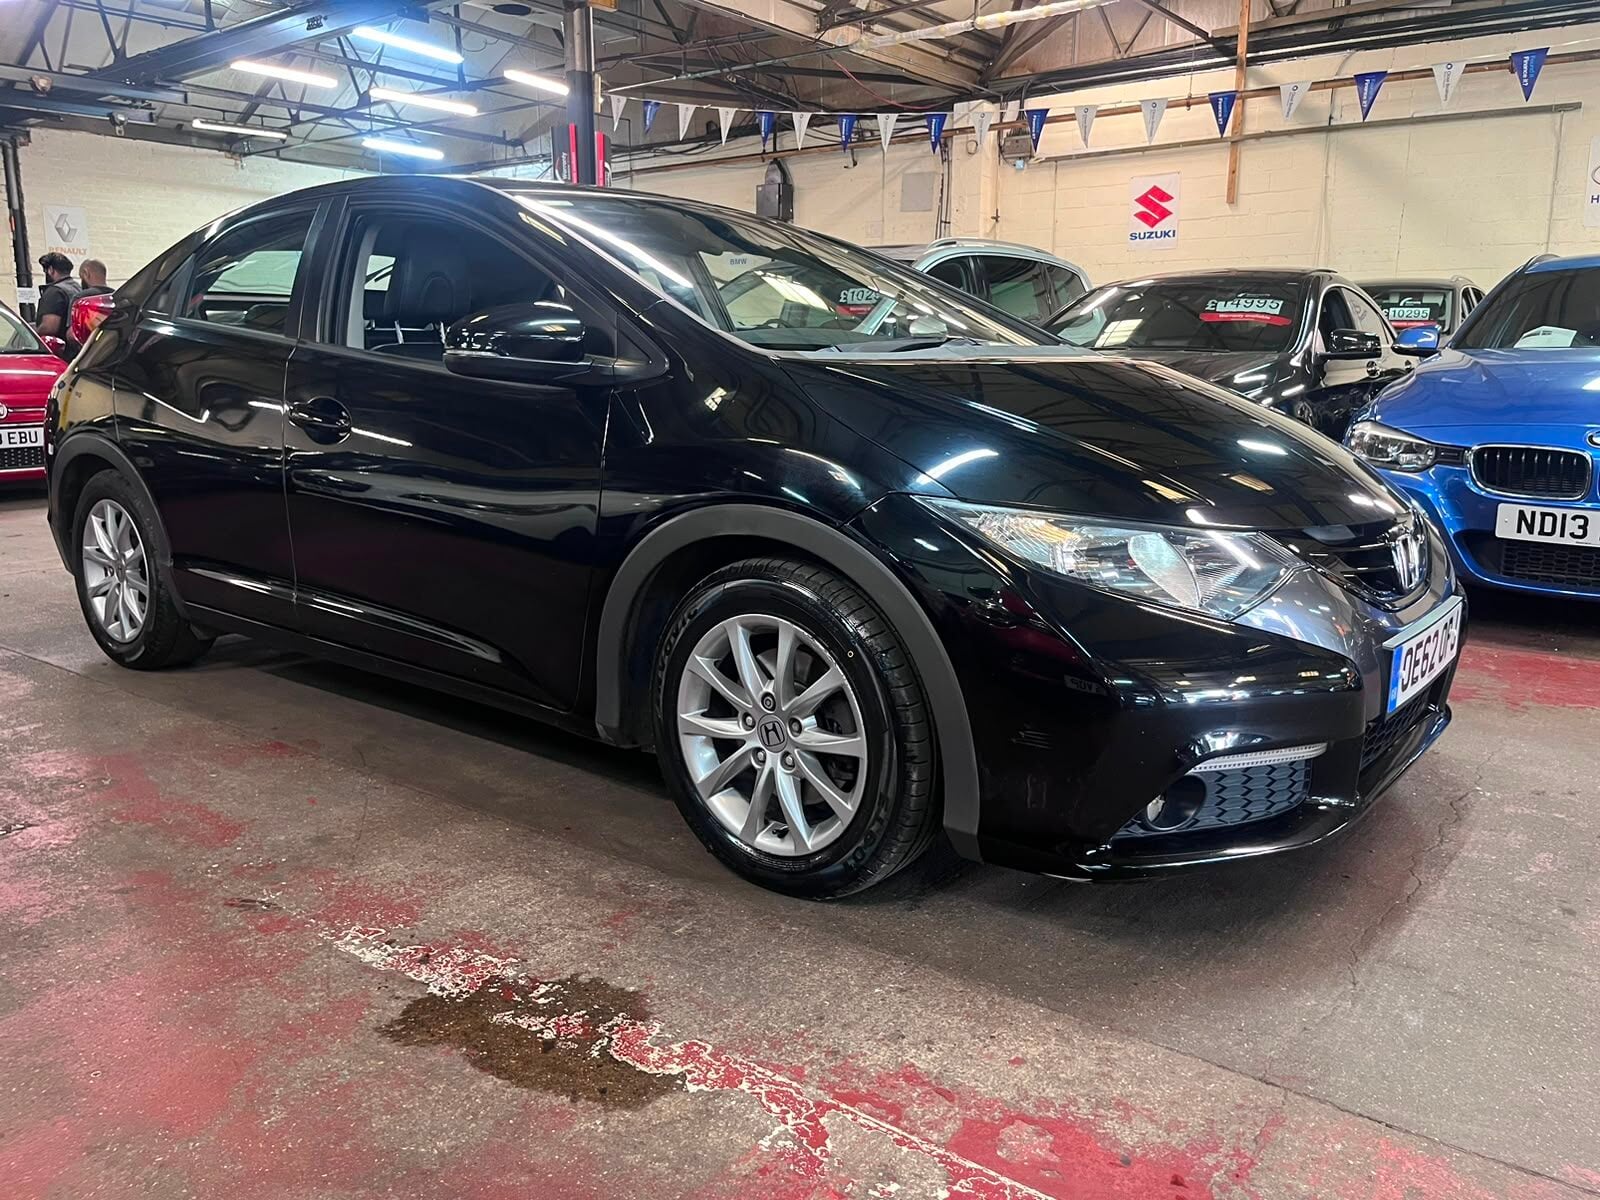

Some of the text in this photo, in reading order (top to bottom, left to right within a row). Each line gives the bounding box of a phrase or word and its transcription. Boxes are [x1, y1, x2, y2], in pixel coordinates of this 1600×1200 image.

[1129, 229, 1176, 240] SUZUKI
[7, 430, 39, 445] EBU
[1516, 509, 1590, 540] ND13
